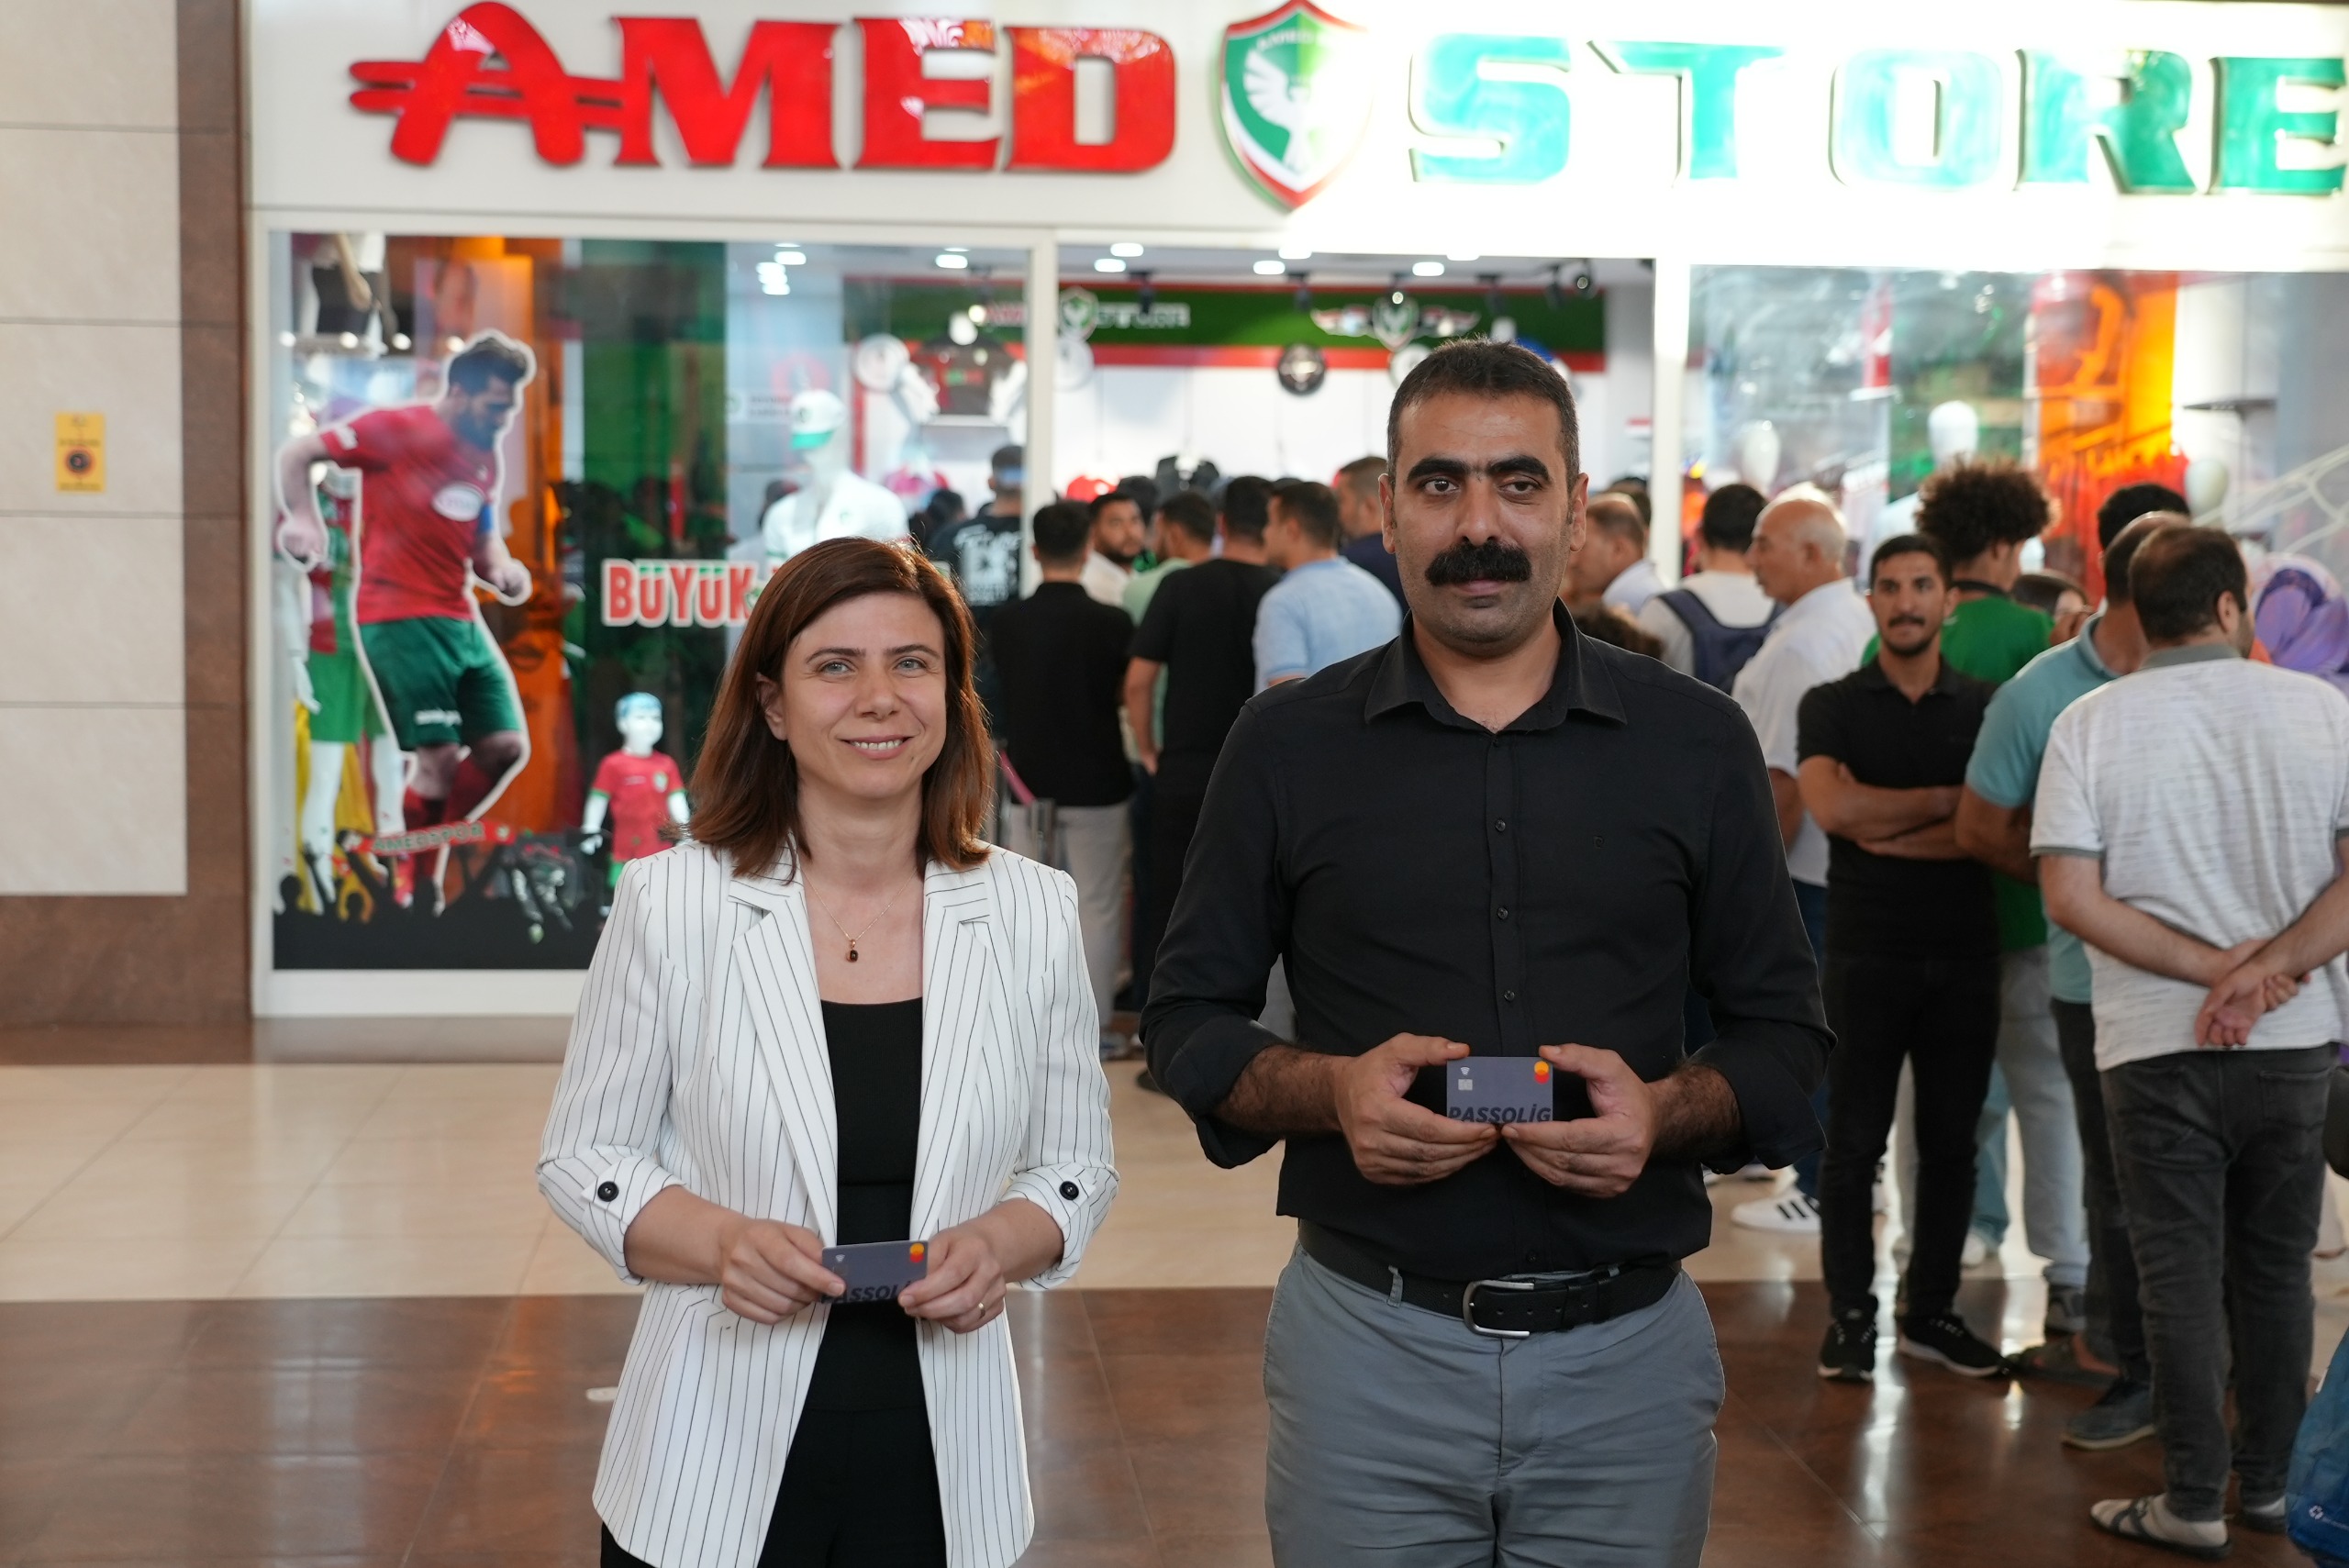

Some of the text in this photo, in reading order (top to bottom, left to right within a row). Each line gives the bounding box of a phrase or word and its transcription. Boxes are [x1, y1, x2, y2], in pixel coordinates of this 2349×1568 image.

[349, 2, 2347, 195] AMED STORE
[606, 562, 756, 625] BÜYÜK
